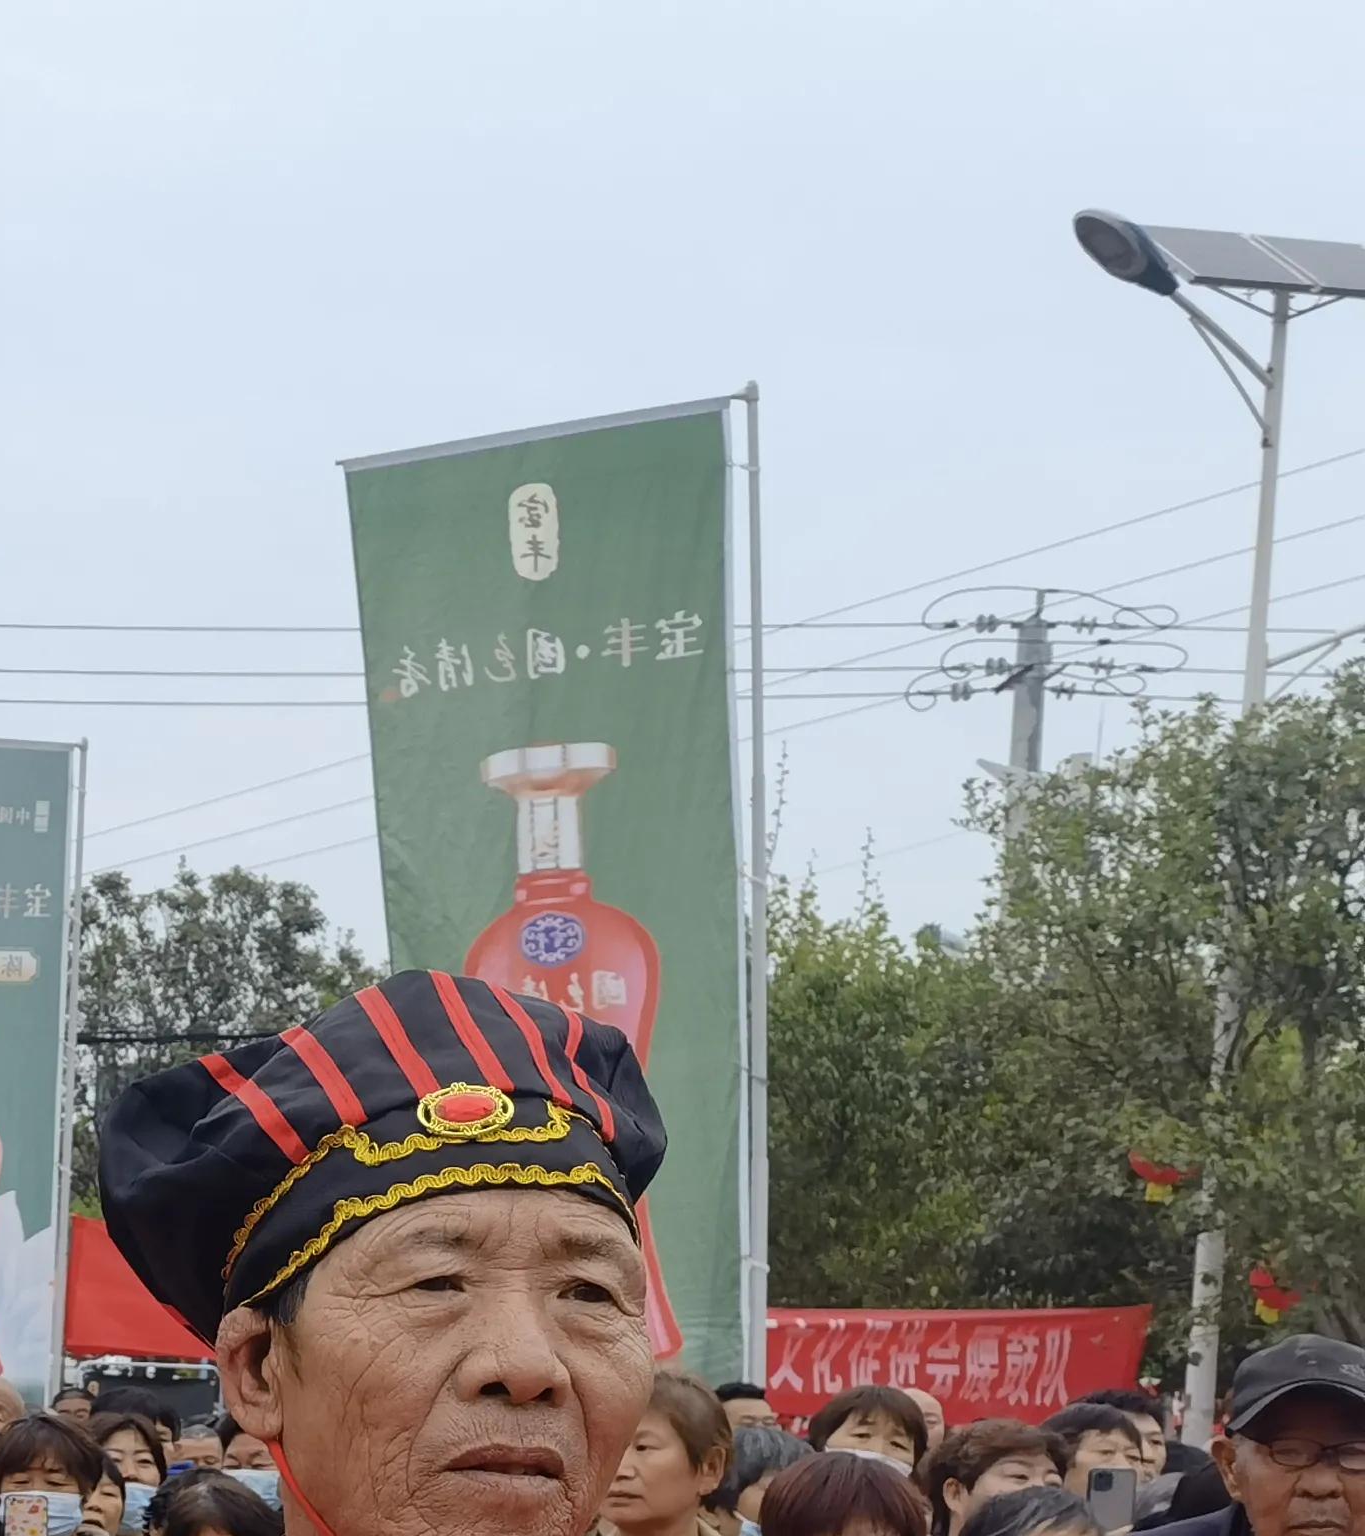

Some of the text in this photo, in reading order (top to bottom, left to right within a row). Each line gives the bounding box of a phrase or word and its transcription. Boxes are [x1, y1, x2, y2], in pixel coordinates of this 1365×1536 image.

[765, 1317, 1072, 1407] 文化促进会腰鼓队
